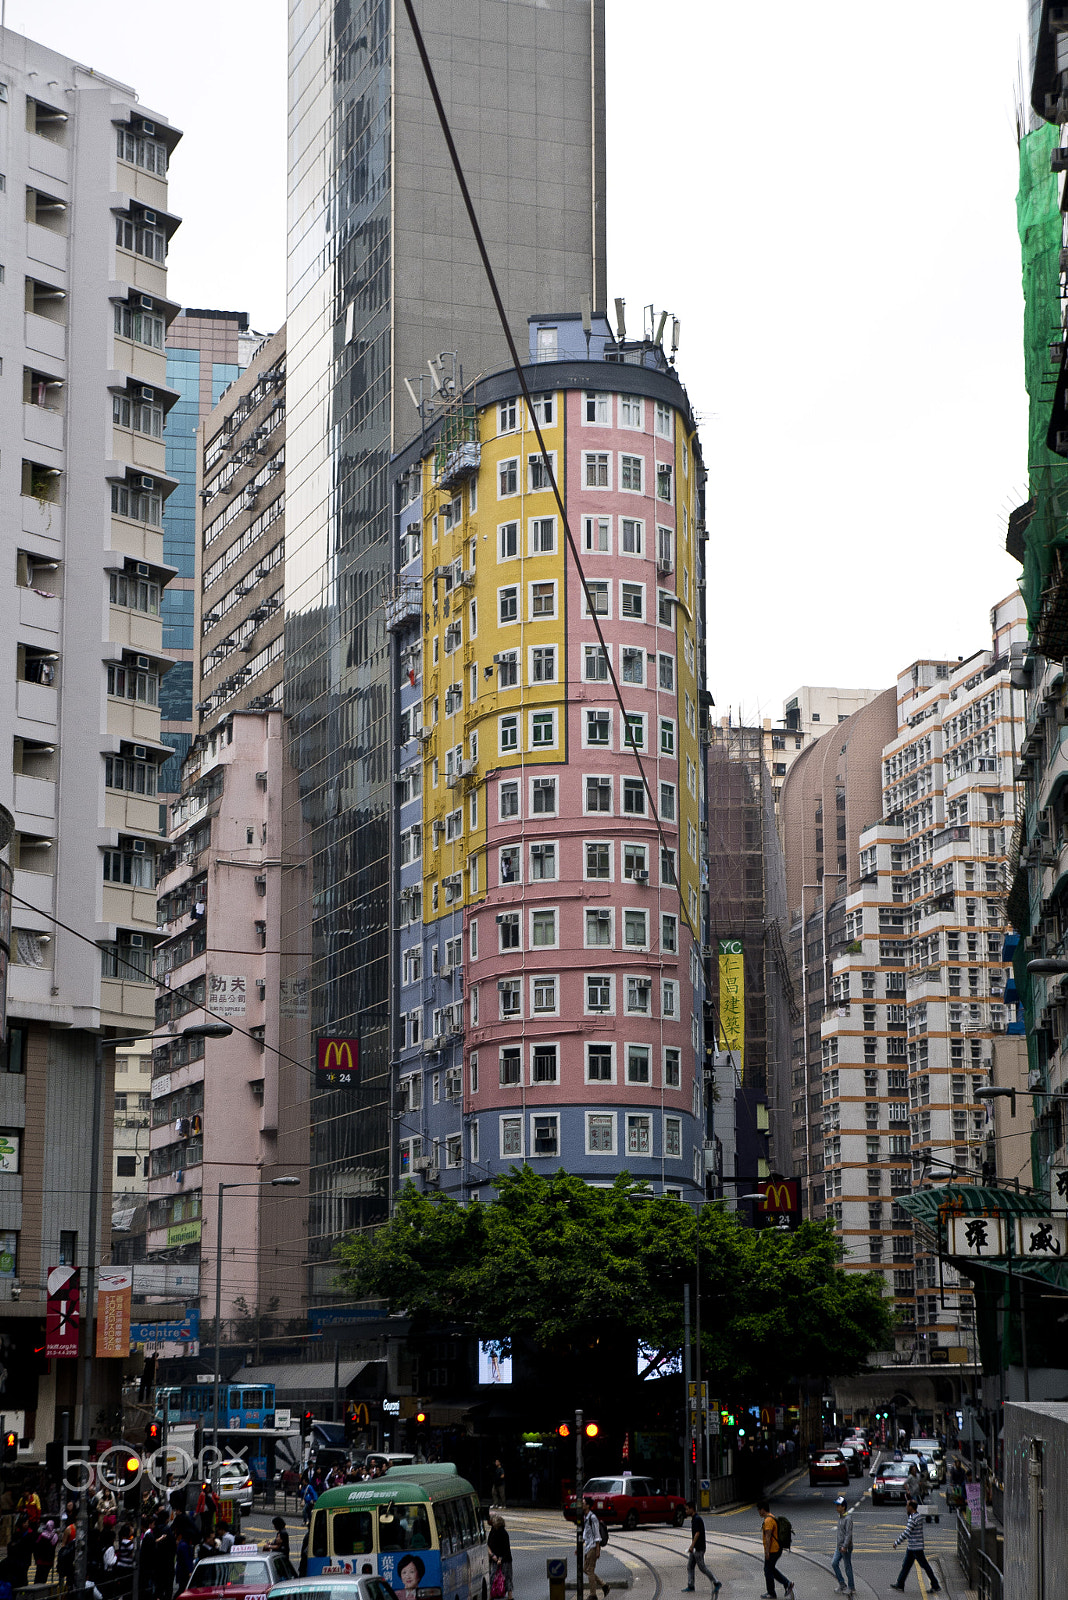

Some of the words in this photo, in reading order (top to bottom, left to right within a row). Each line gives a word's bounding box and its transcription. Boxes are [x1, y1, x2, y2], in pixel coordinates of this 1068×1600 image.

[719, 941, 742, 954] YC
[211, 976, 246, 993] 功夫
[209, 994, 246, 1003] 用品公司
[339, 1073, 352, 1083] 24
[139, 1327, 180, 1337] Centre
